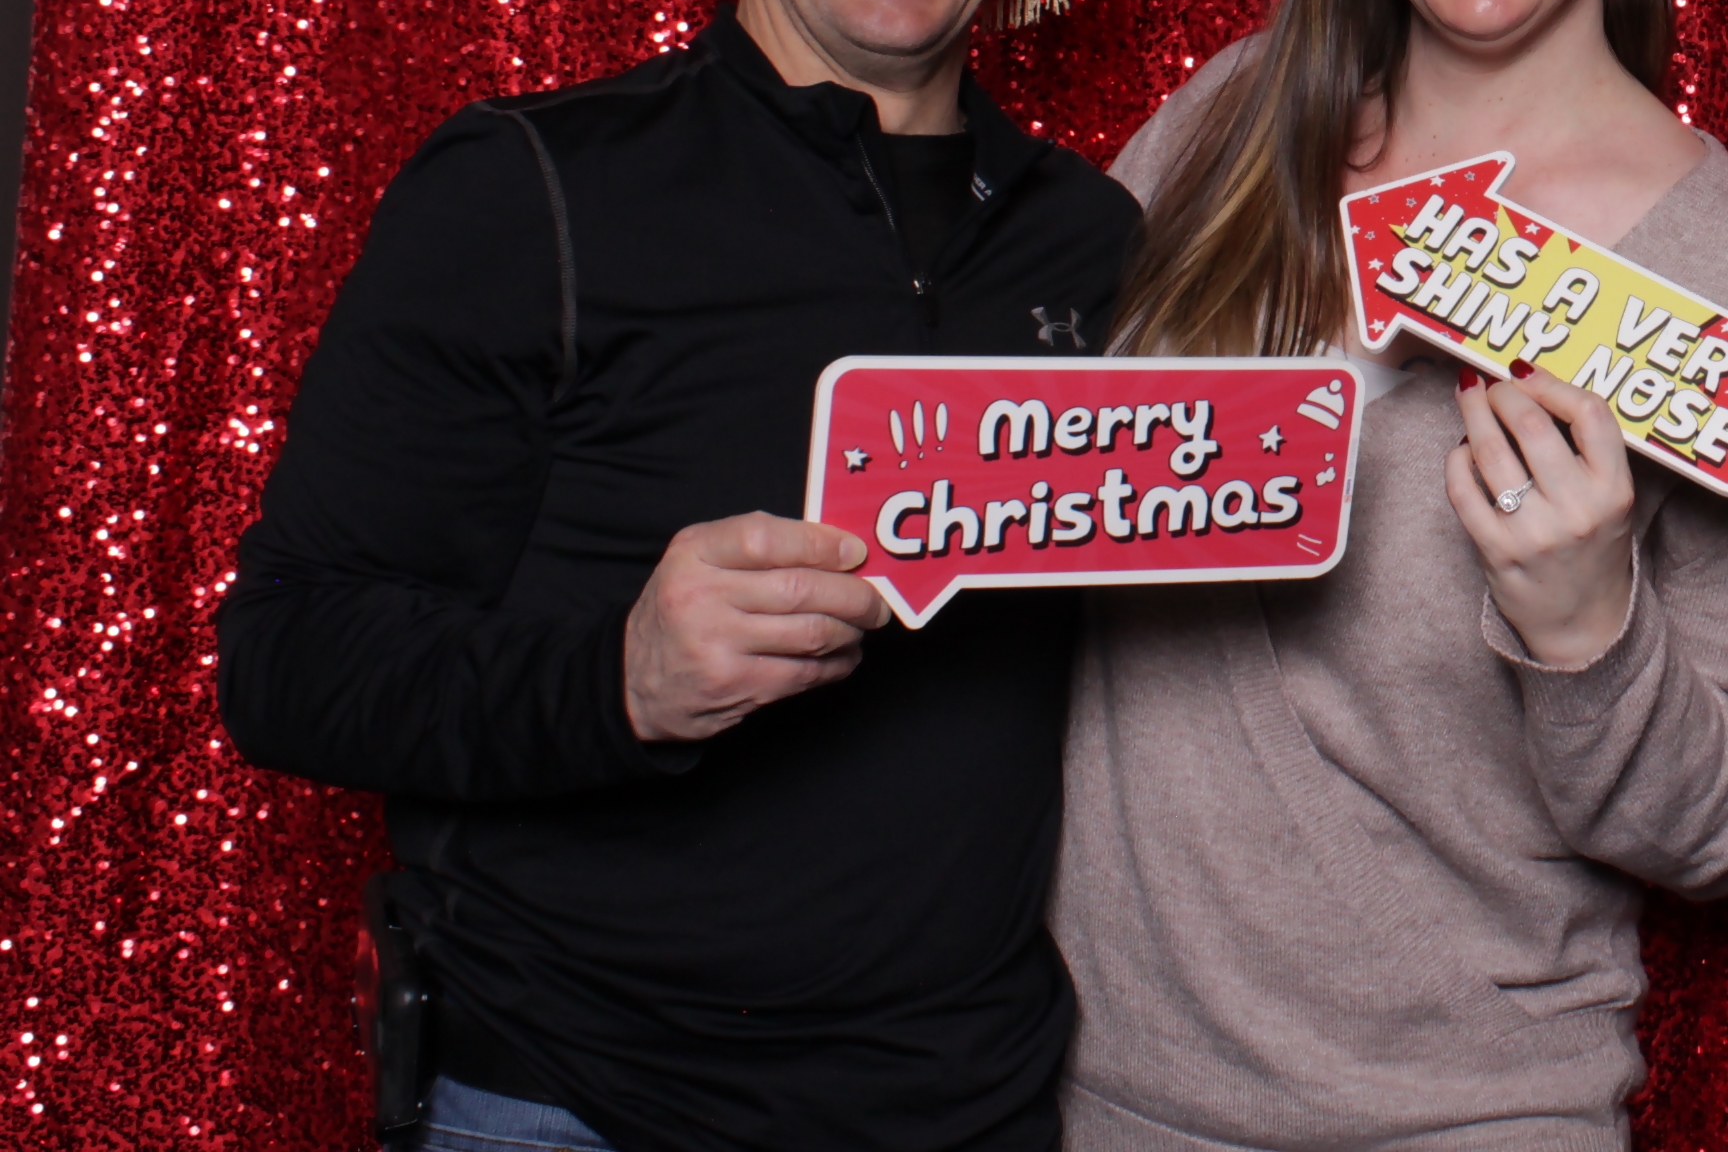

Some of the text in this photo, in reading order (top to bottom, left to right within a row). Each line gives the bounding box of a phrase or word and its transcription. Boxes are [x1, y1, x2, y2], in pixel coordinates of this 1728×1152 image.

[1375, 246, 1571, 363] SHINY
[1404, 193, 1541, 288] HAS
[1541, 266, 1600, 325] A
[977, 398, 1220, 477] Merry
[874, 467, 1303, 557] Christmas
